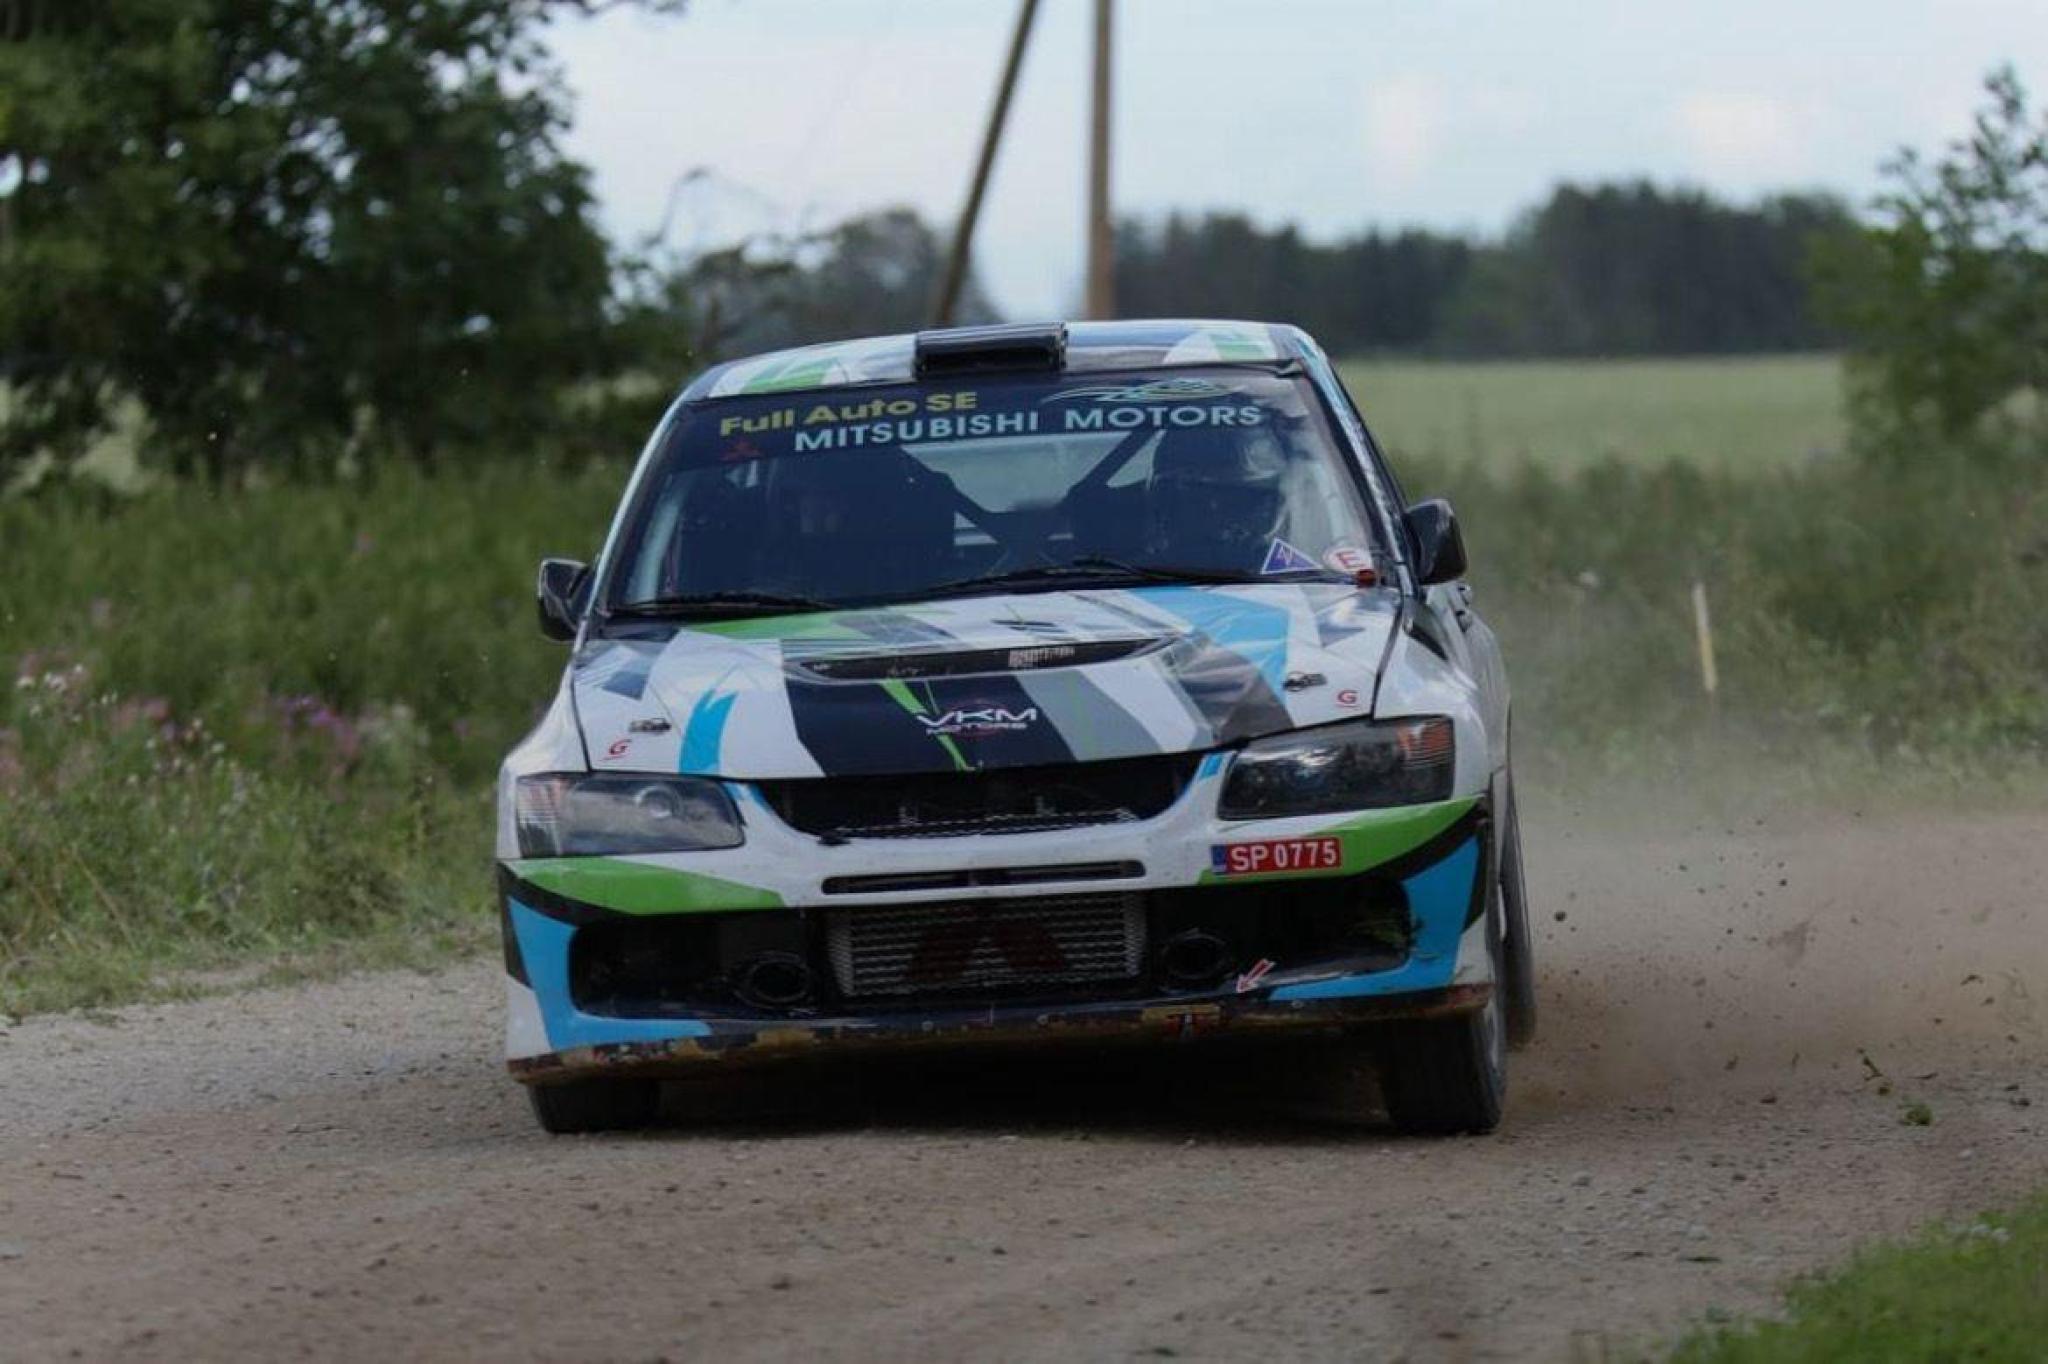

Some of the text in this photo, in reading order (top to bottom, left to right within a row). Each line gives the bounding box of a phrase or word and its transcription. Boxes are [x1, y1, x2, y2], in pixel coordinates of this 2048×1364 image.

[719, 391, 978, 437] Full Auto SE
[794, 404, 1262, 452] MITSUBISHI MOTORS
[1230, 840, 1337, 871] SP 0775
